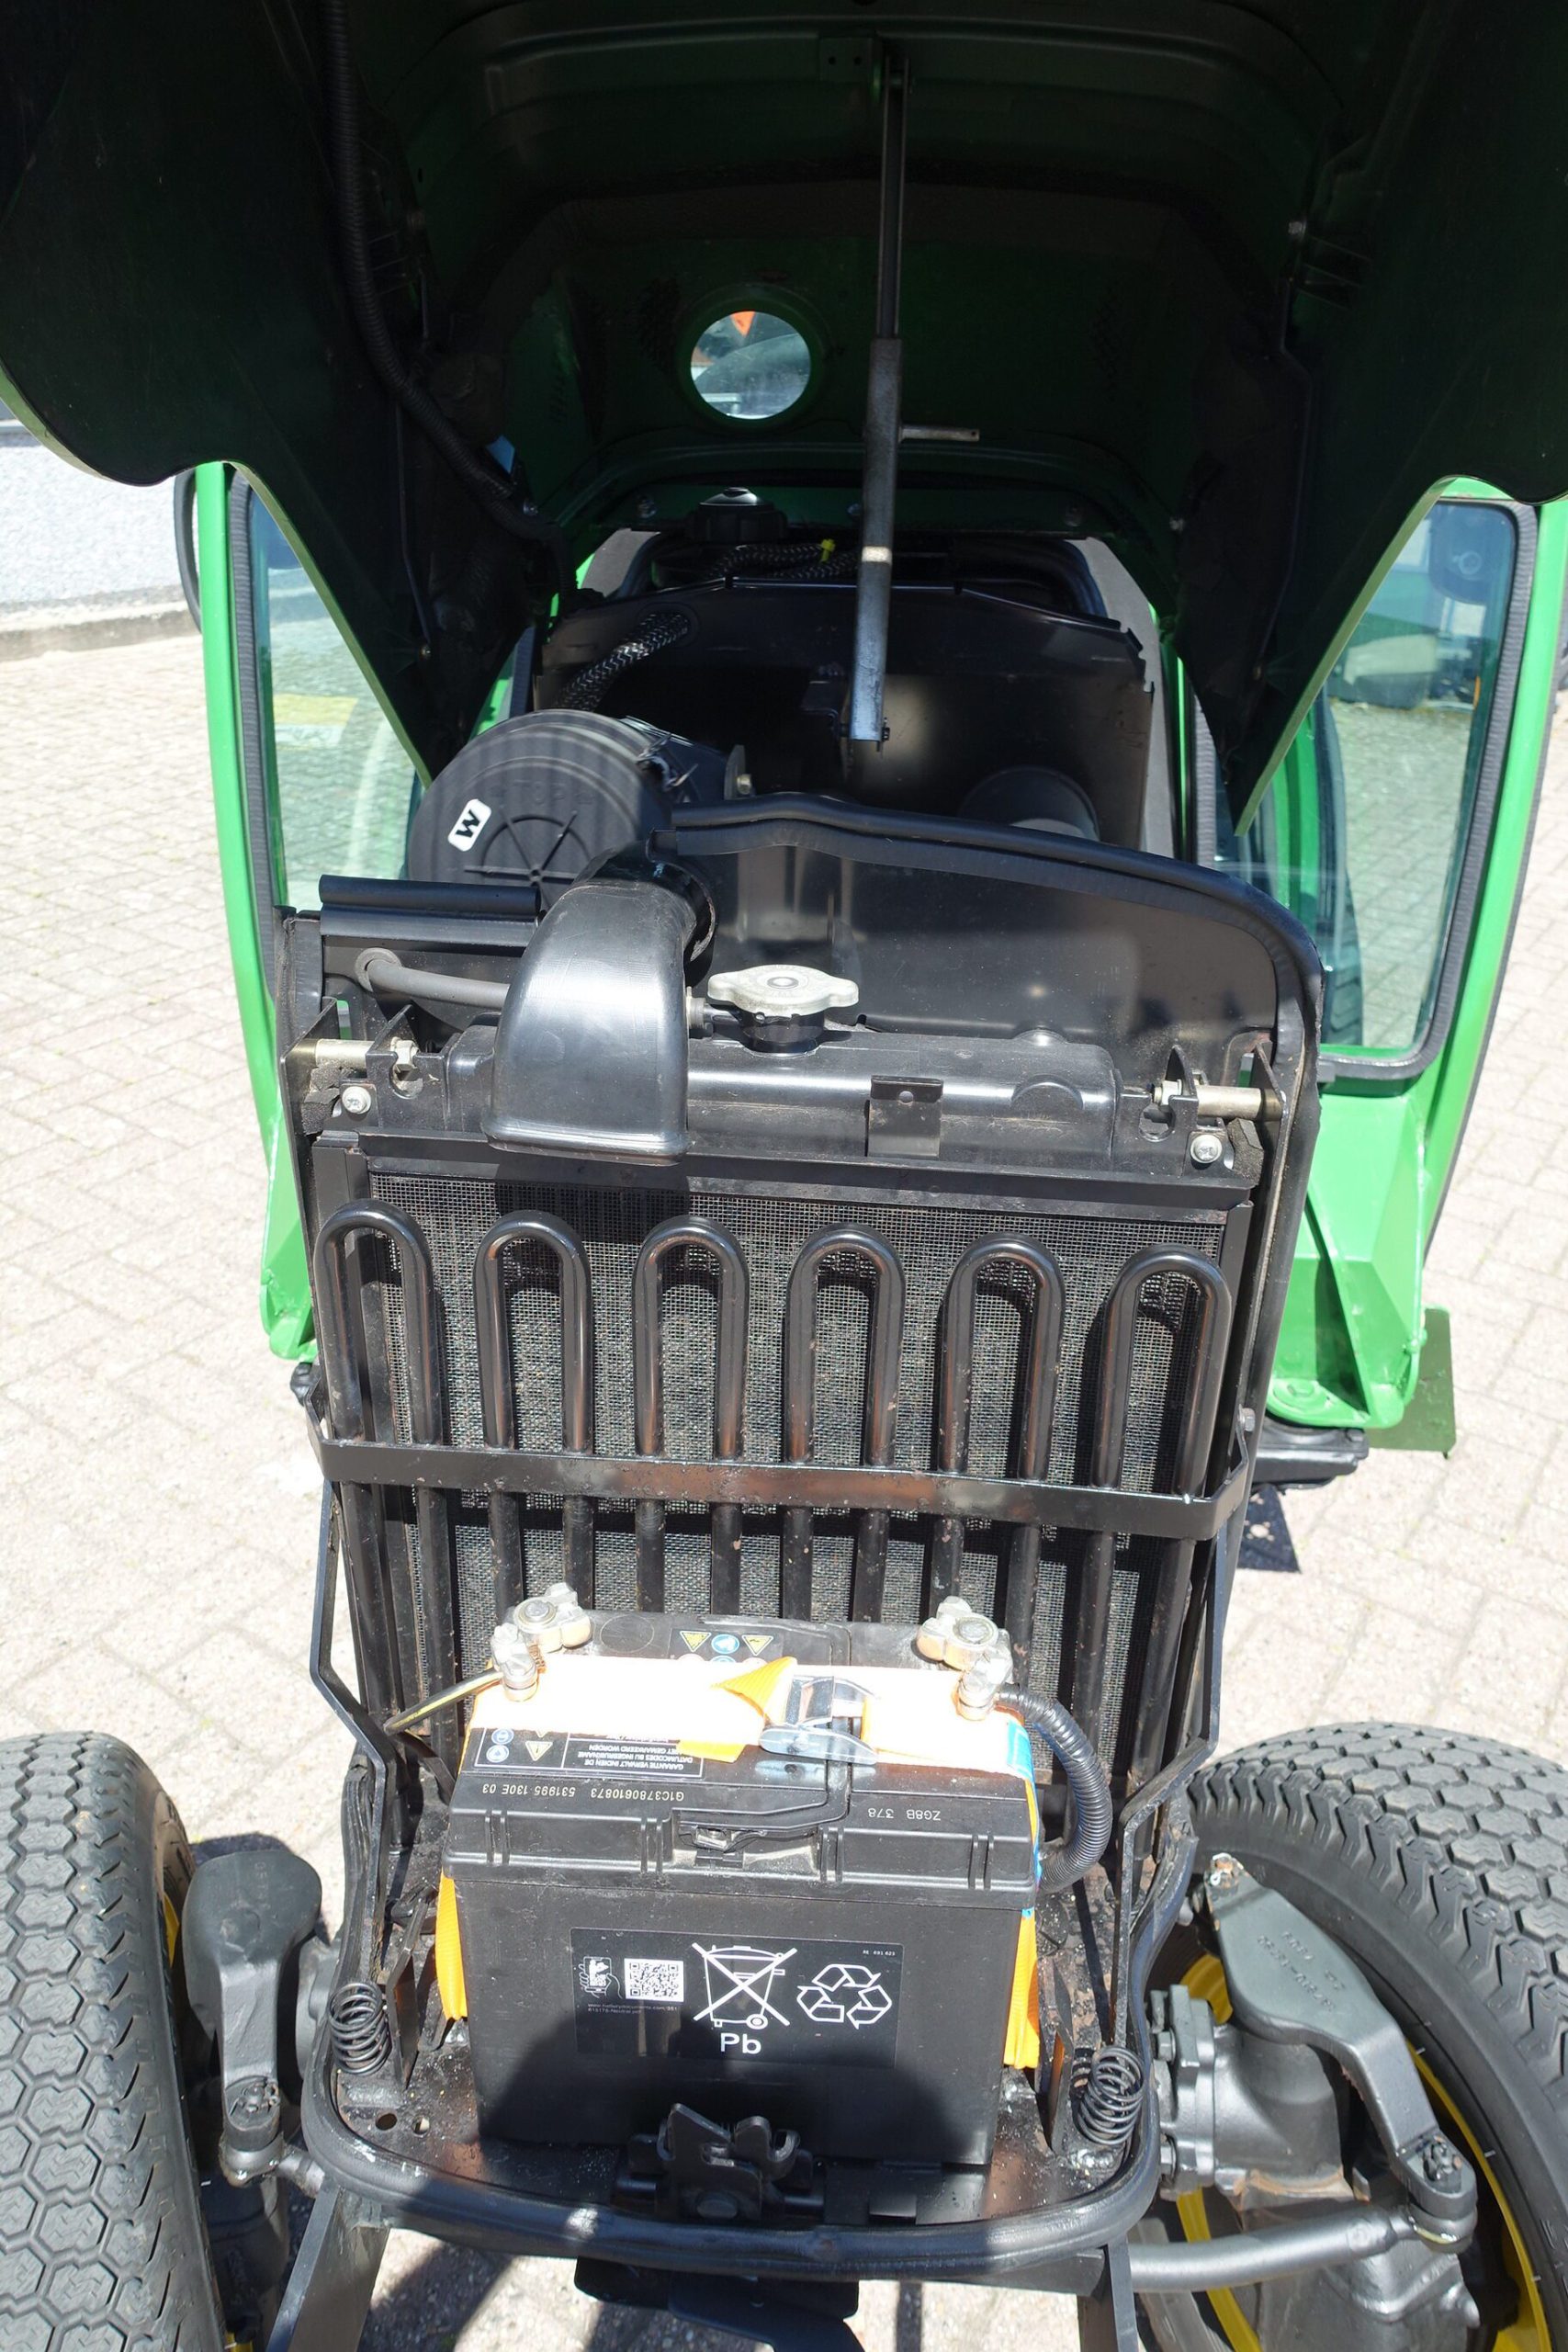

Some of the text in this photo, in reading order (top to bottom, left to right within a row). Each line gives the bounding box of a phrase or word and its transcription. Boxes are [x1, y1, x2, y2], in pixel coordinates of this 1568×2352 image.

[620, 1746, 667, 1754] GEMARKEERD
[578, 1751, 634, 1760] INGEBRUIKNAME
[645, 1754, 694, 1763] DATUMCODES
[595, 1758, 619, 1767] INDIEN
[620, 1760, 648, 1769] VERVALT
[648, 1761, 684, 1770] GARANTIE
[482, 1783, 684, 1802] G1C3780610873 531995 130E 03
[867, 1807, 942, 1821] ZG8B 378
[720, 2032, 762, 2055] Pb
